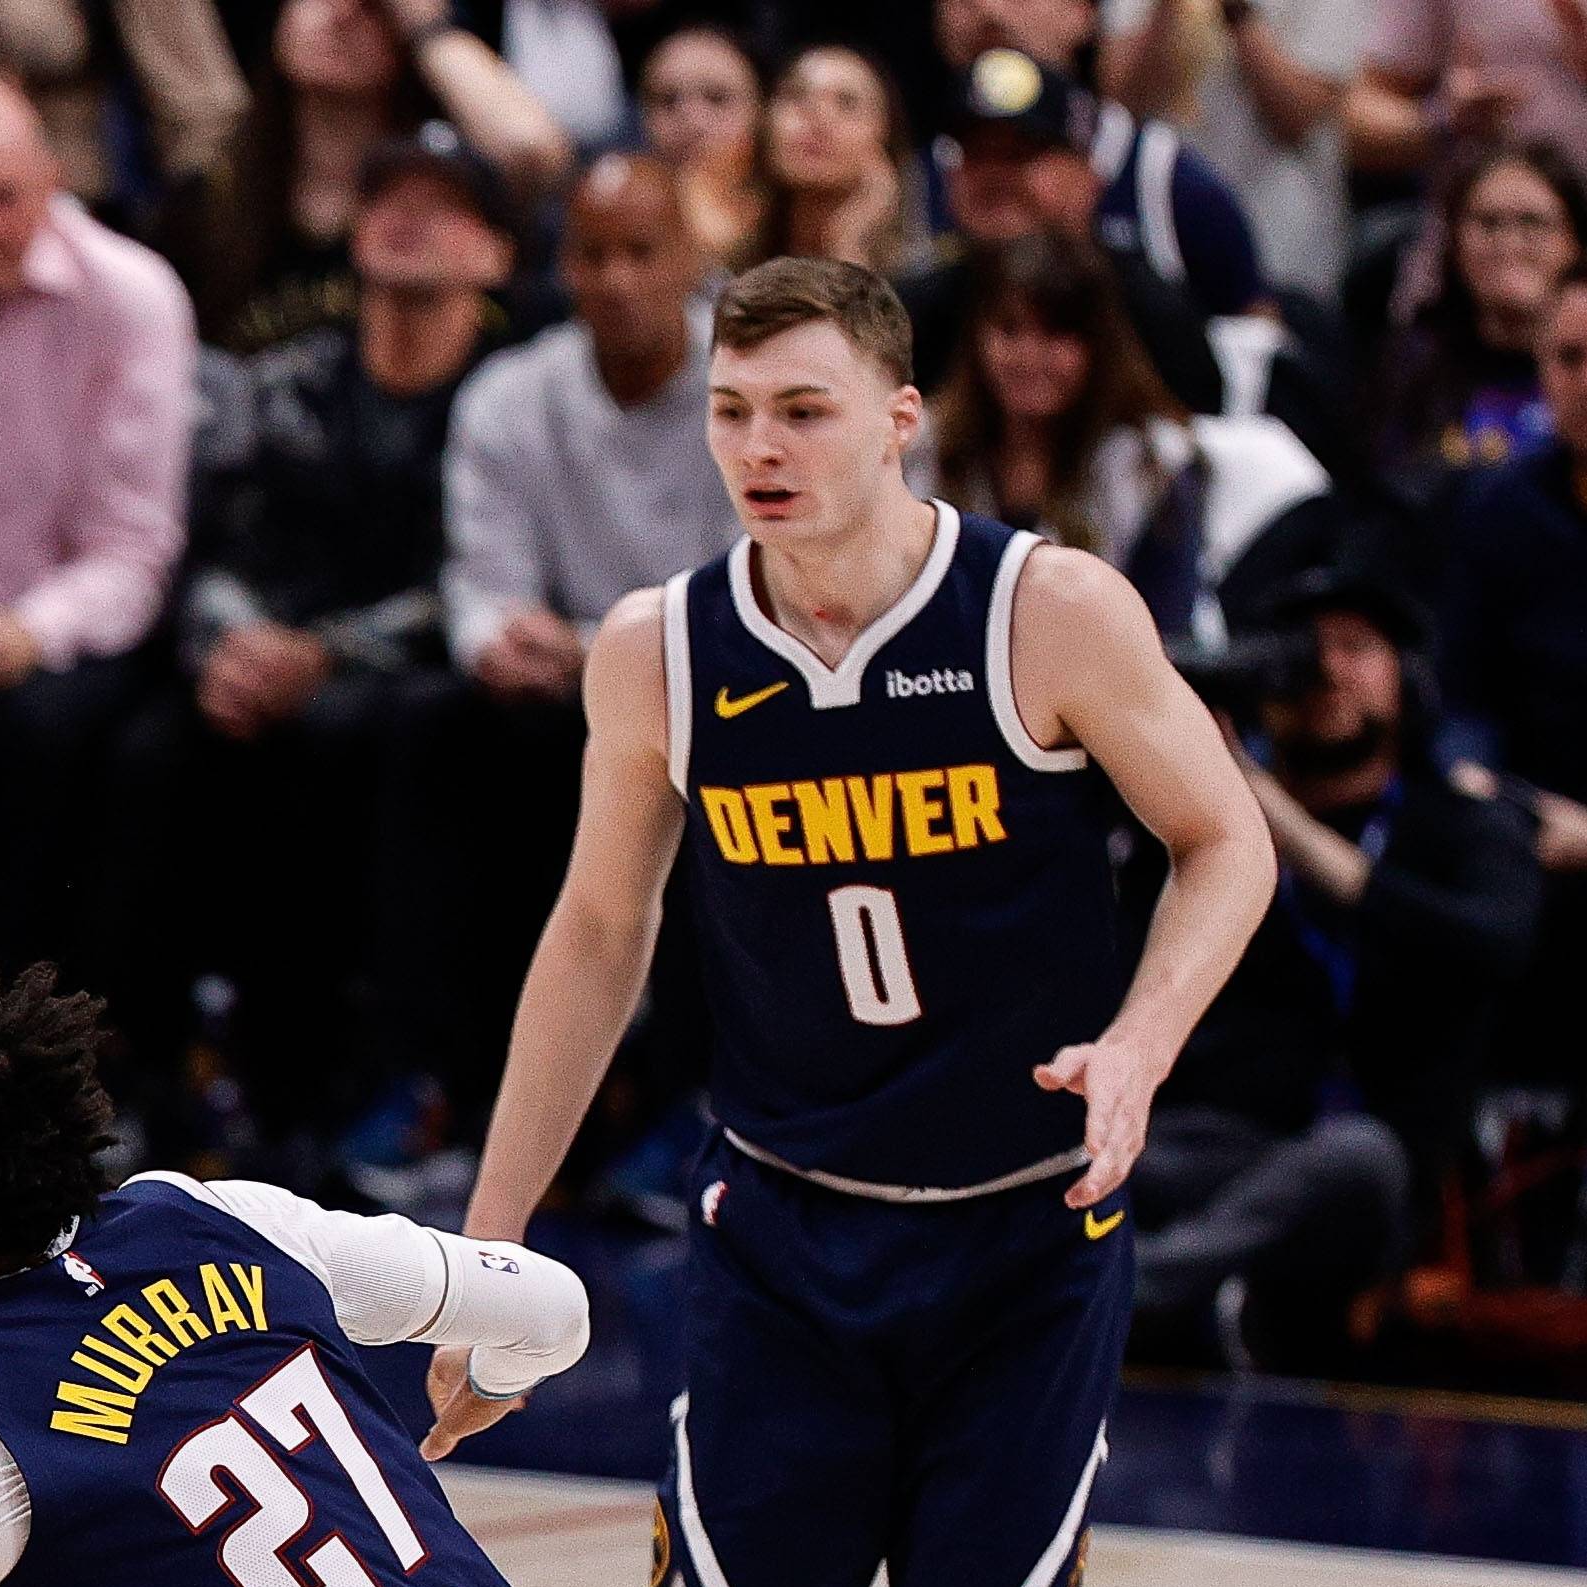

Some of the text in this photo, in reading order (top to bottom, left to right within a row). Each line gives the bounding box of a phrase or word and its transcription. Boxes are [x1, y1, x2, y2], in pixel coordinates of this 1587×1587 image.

[886, 667, 974, 698] ibotta
[699, 764, 1008, 866] DENVER
[827, 884, 923, 1026] 0
[50, 1262, 269, 1445] MURRAY
